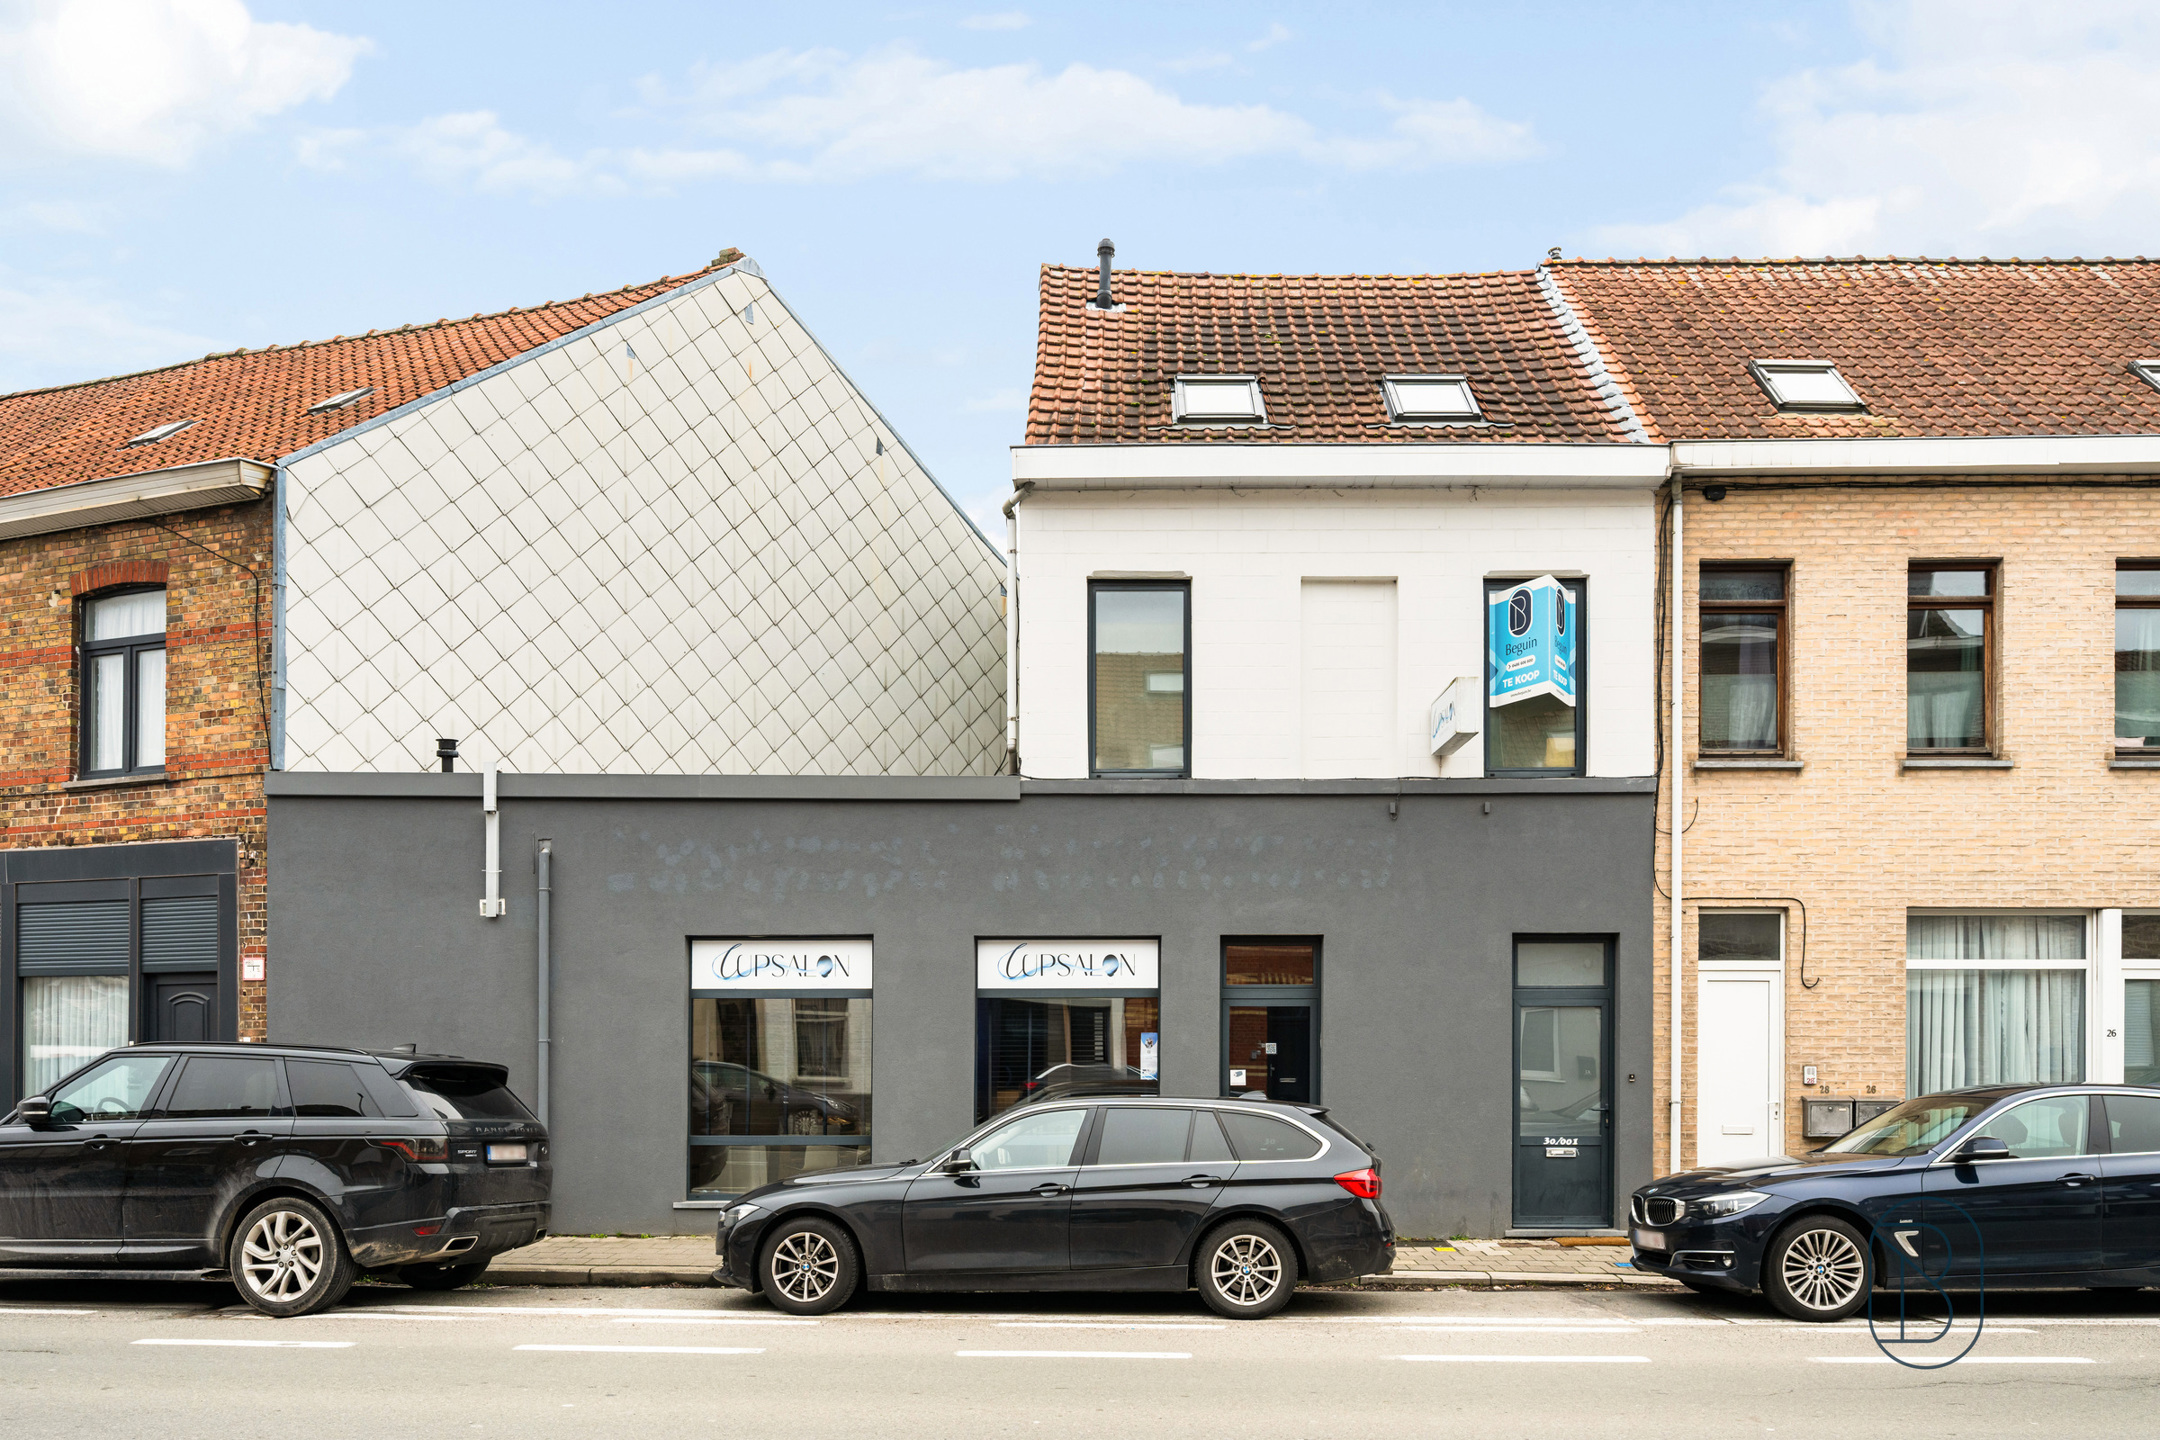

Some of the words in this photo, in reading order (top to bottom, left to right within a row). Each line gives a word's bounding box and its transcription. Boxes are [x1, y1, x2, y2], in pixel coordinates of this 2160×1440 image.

[1505, 637, 1538, 656] Beguin
[1502, 677, 1514, 688] TE
[1514, 669, 1540, 685] KOOP
[2106, 1029, 2117, 1038] 26
[1806, 1077, 1815, 1085] 28
[1820, 1085, 1830, 1094] 28
[1866, 1085, 1877, 1094] 26
